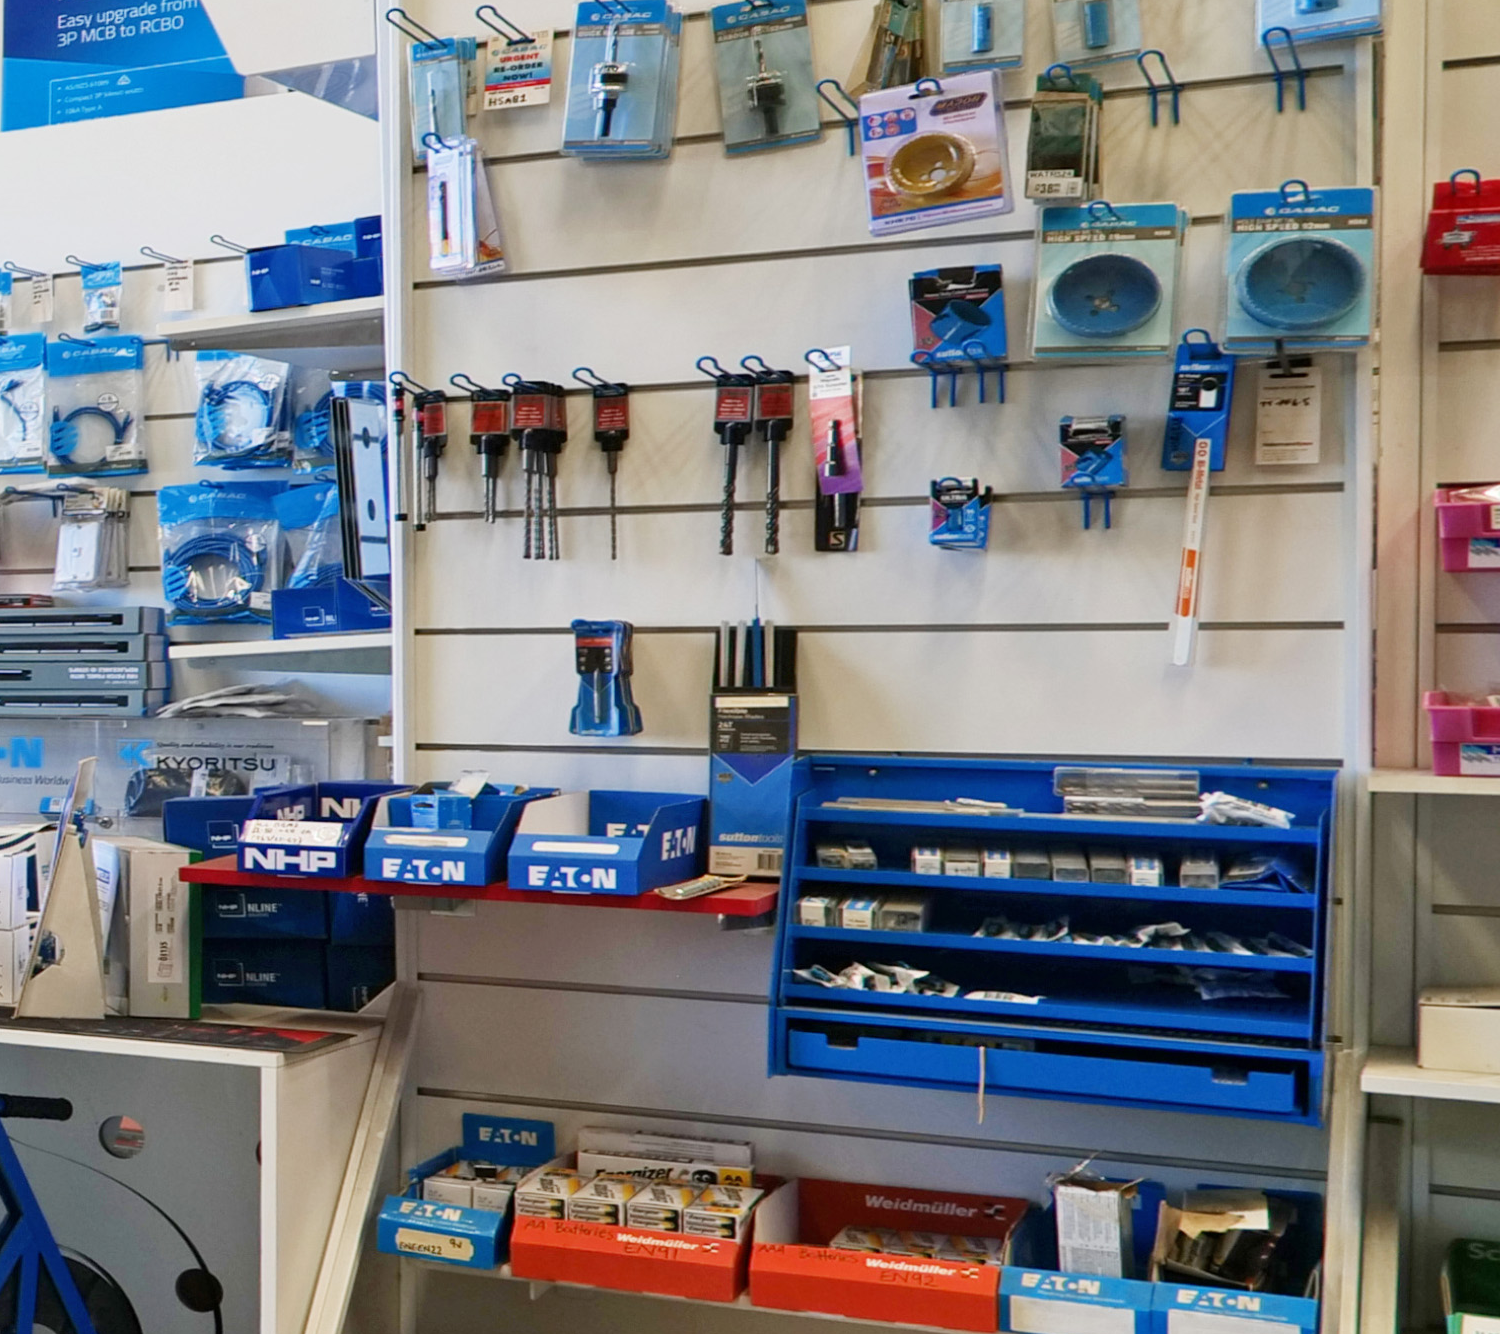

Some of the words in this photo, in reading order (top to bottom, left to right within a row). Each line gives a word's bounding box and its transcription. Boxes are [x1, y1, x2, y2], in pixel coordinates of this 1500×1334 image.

[58, 13, 92, 29] Easy
[96, 1, 157, 25] upgrade
[603, 11, 652, 20] CABAC
[739, 6, 790, 20] CABAC
[57, 31, 78, 47] 3P
[81, 25, 116, 43] MCB
[120, 24, 135, 37] to
[140, 15, 184, 35] RCBO
[500, 53, 539, 63] URGENT
[1279, 206, 1340, 214] CABAC
[157, 757, 275, 771] KYORITSU
[244, 847, 336, 872] NHP
[382, 858, 465, 882] EATON
[528, 865, 616, 889] EATON
[247, 903, 278, 912] NLINE
[246, 972, 276, 982] NLINE
[479, 1127, 537, 1146] EATON
[399, 1201, 462, 1221] EATON
[865, 1195, 978, 1218] Weidmüller
[616, 1232, 698, 1250] Weidmüller
[865, 1258, 956, 1276] Weidmüller
[1021, 1272, 1100, 1295] EATON
[1176, 1289, 1261, 1312] EATON
